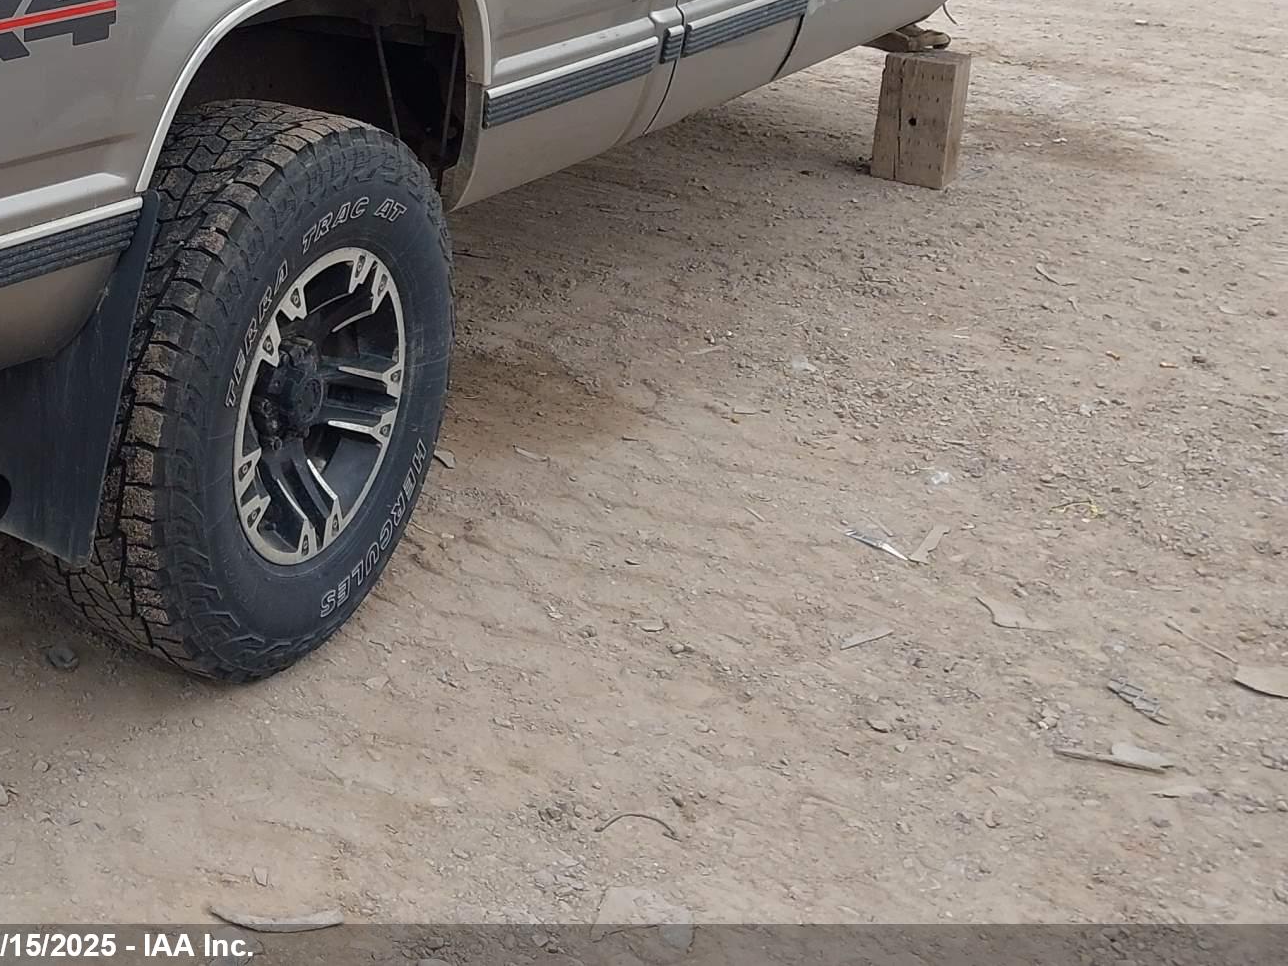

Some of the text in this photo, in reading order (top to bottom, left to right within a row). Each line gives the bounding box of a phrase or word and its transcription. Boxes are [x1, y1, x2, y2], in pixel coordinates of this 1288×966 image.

[225, 196, 408, 408] TERRA TRAC AT
[320, 438, 427, 618] HERCULES
